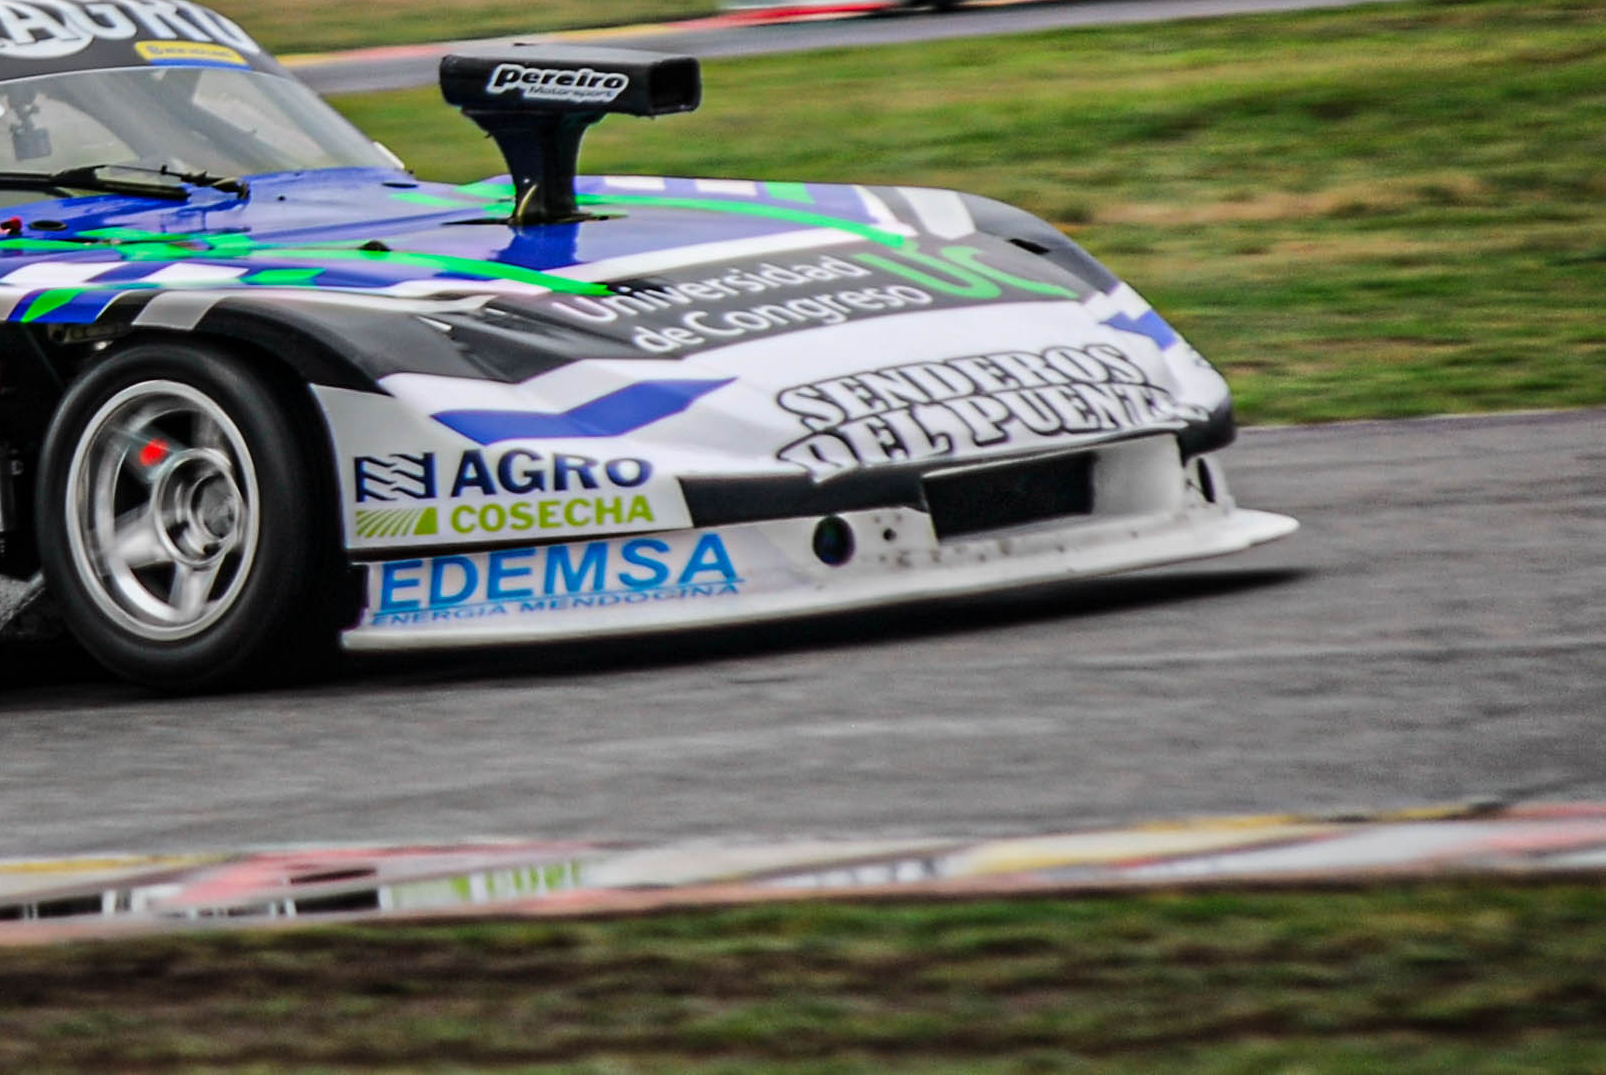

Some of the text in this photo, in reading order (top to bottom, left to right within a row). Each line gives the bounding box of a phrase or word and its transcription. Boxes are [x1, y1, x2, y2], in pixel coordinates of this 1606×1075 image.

[493, 67, 626, 89] pereiro
[551, 254, 874, 325] Universidad
[777, 343, 1149, 433] SENDEROS
[450, 447, 654, 498] AGRO
[776, 402, 953, 484] DEL
[450, 495, 655, 534] COSECHA
[379, 533, 740, 613] EDEMSA
[518, 583, 740, 614] MENDOCINA
